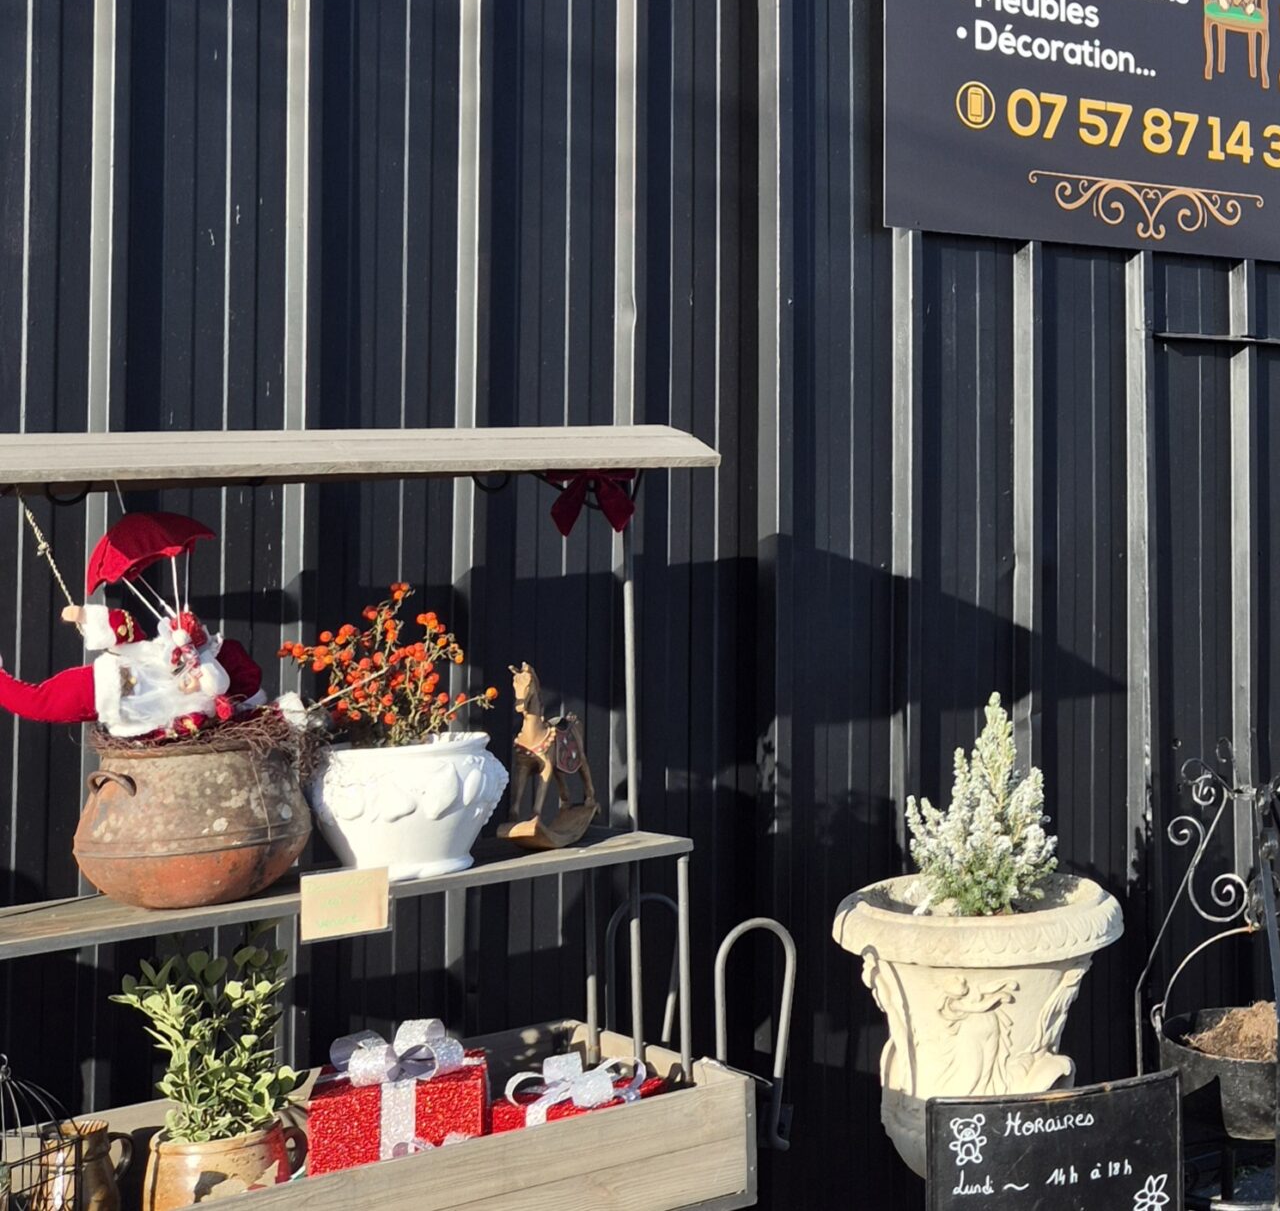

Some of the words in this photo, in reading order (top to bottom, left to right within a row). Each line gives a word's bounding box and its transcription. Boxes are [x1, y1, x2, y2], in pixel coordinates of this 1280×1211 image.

[974, 19, 1156, 77] Décoration...
[1007, 88, 1067, 139] 07
[1079, 99, 1132, 147] 57
[1142, 108, 1198, 156] 87
[1207, 116, 1253, 163] 14
